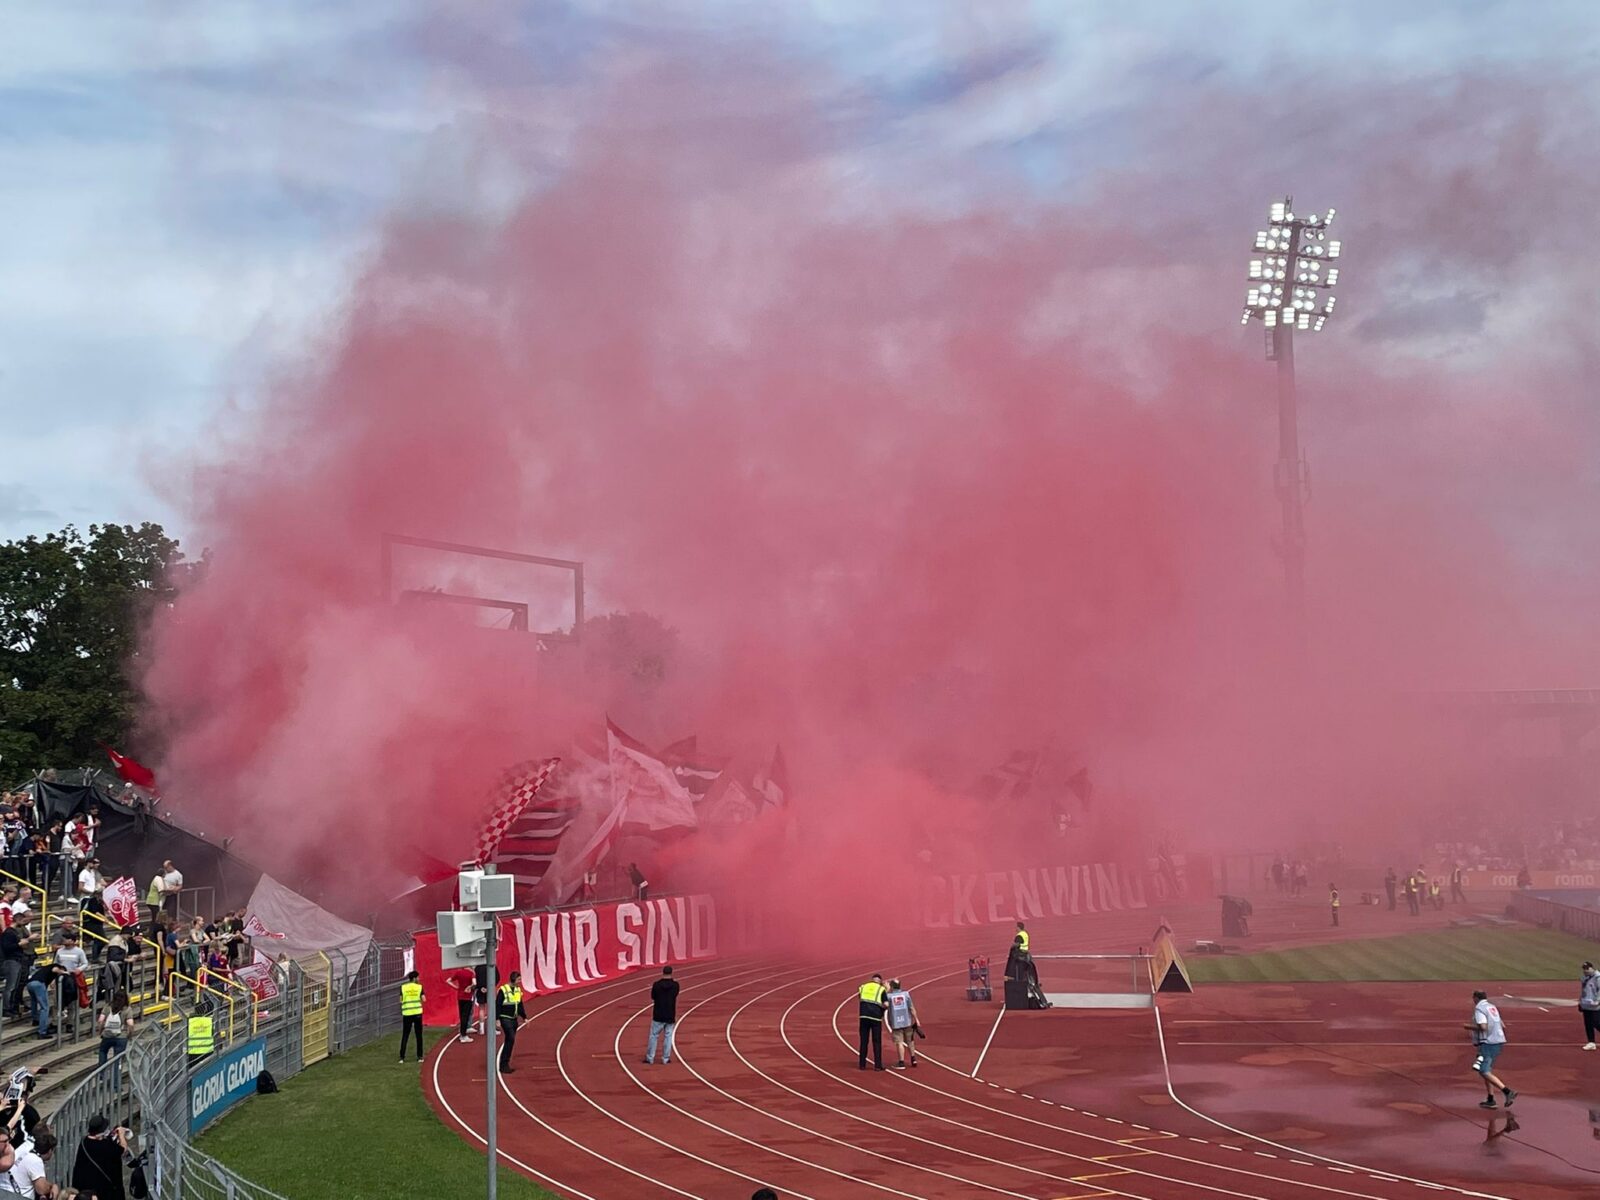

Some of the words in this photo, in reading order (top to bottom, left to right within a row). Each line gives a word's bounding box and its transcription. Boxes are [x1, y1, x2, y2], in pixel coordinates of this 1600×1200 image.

[1555, 873, 1595, 887] roma
[512, 908, 606, 993] WIR
[616, 893, 717, 971] SIND
[918, 861, 1149, 930] CKENWIND
[192, 1069, 226, 1119] GLORIA
[227, 1049, 265, 1092] GLORIA
